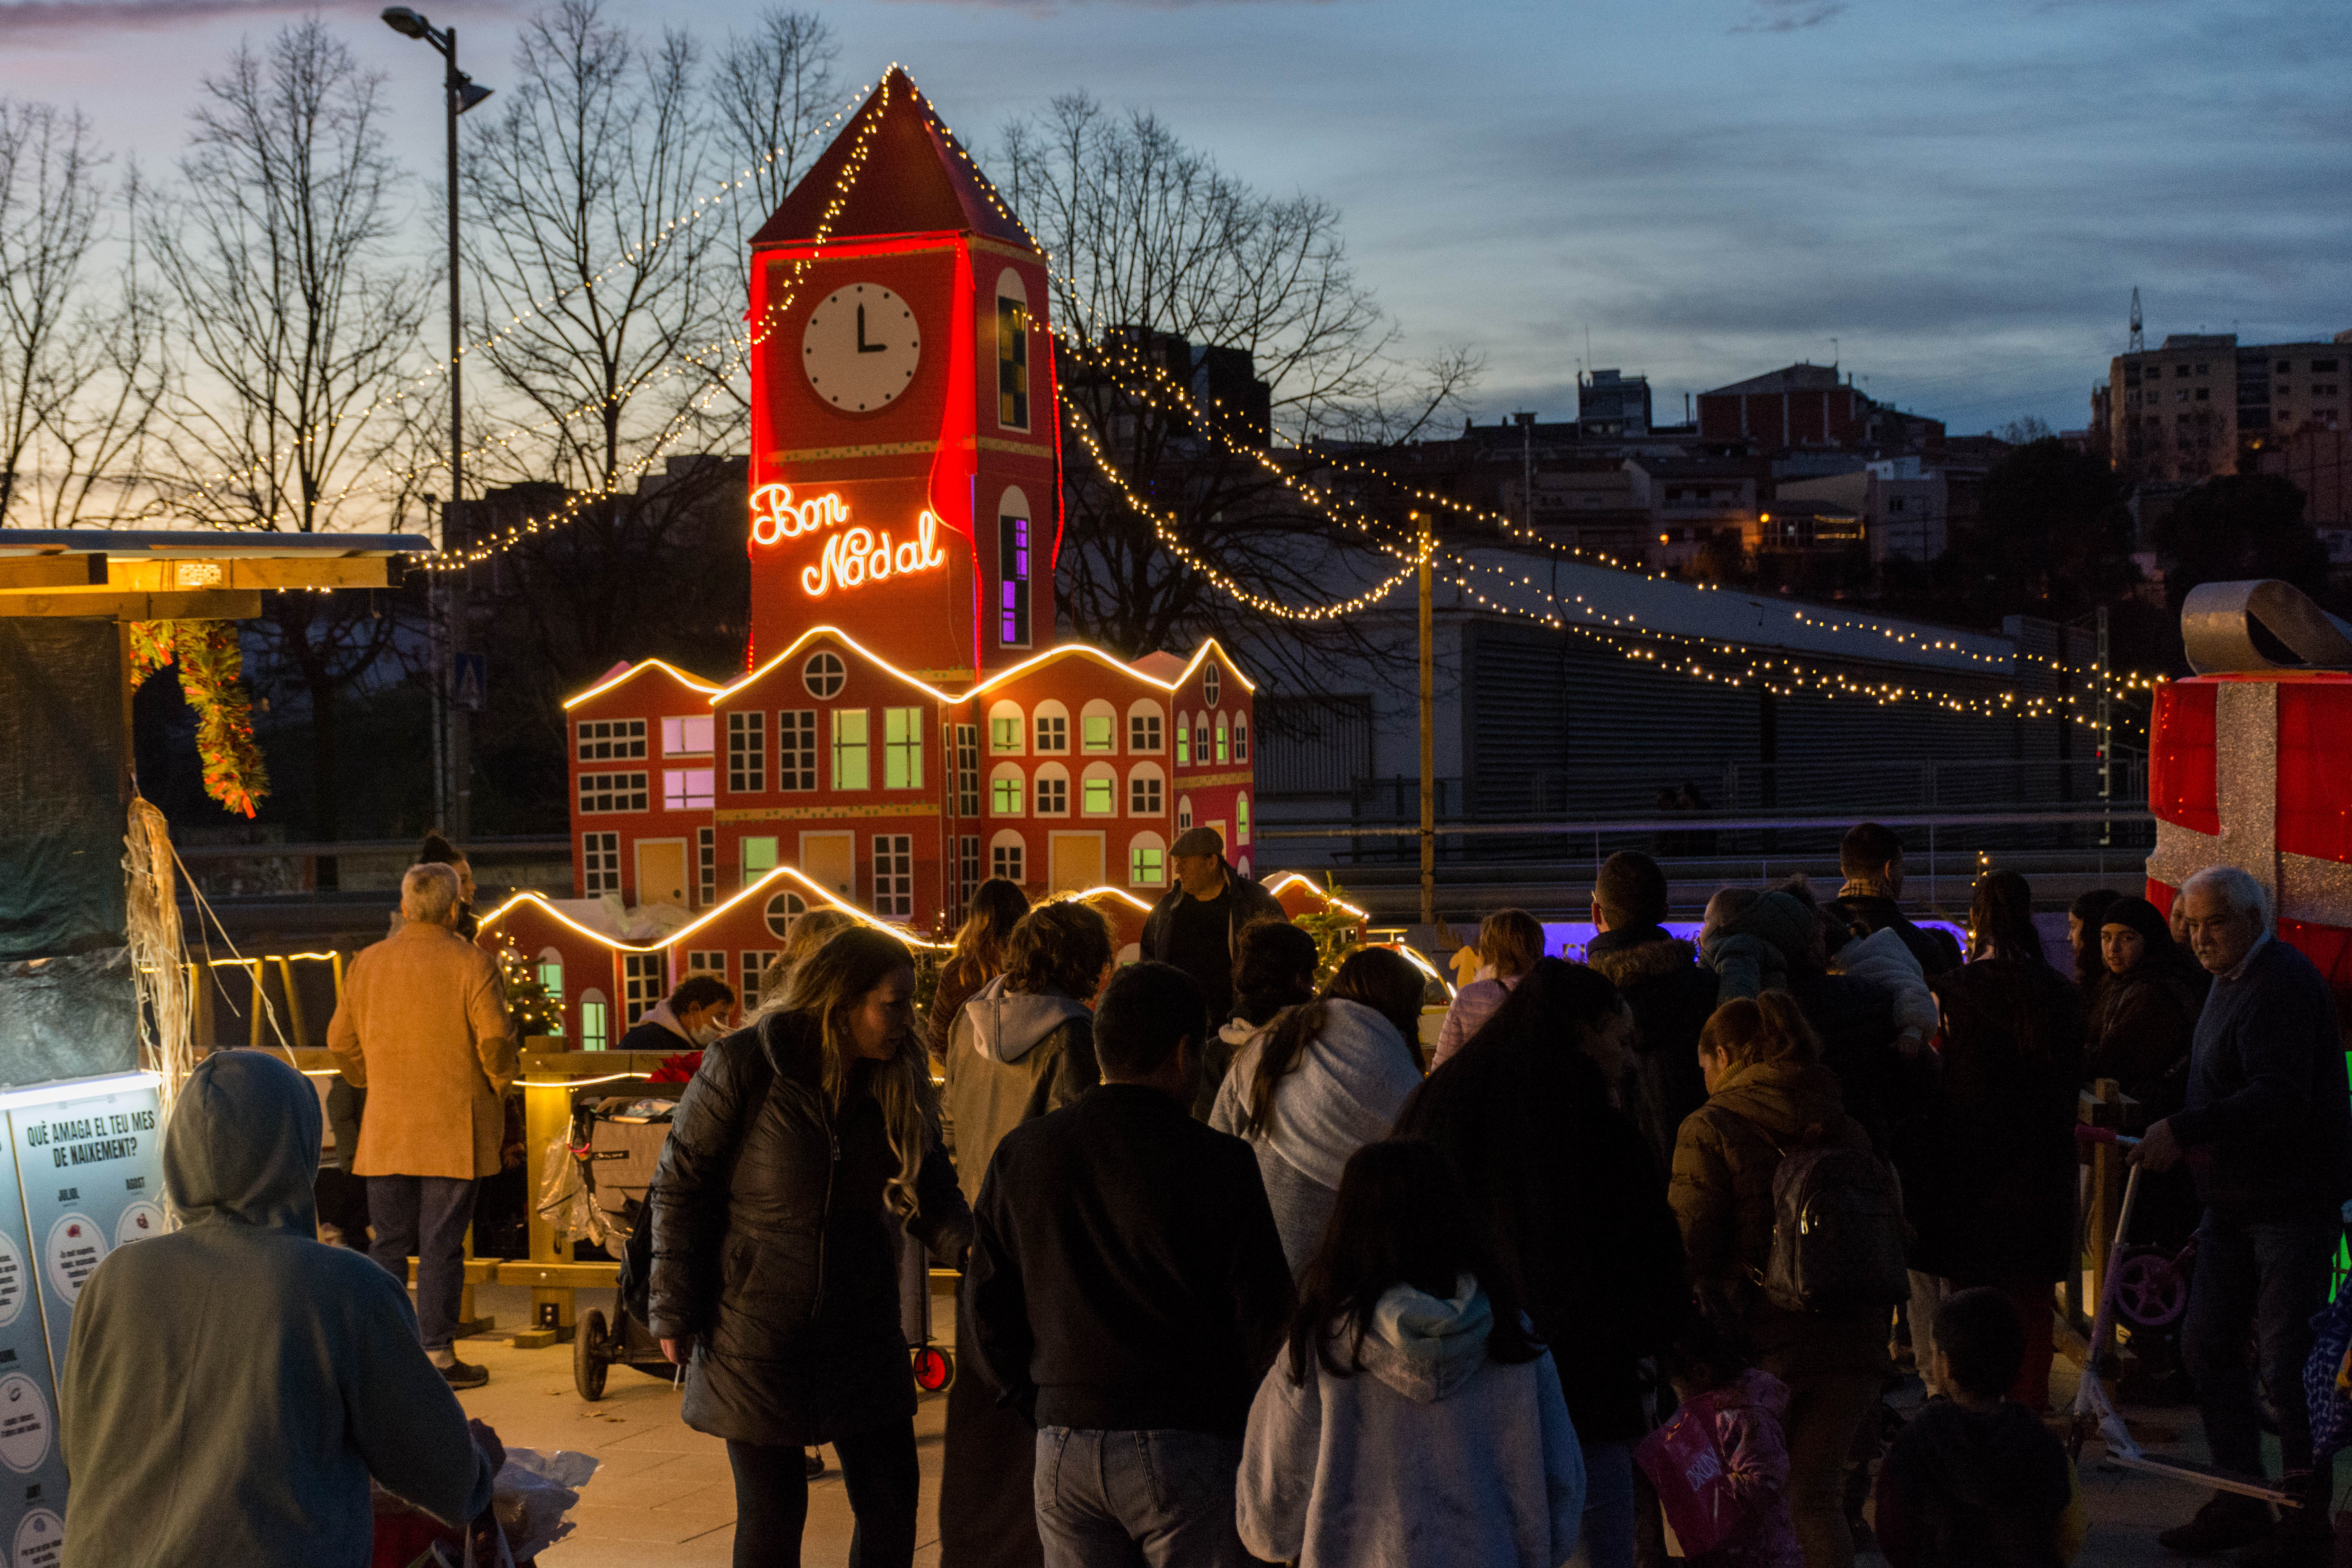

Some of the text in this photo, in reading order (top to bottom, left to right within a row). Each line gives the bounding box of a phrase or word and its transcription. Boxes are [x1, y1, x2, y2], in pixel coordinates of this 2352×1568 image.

[750, 483, 848, 545] Bon
[802, 510, 944, 596] Nadal
[27, 1120, 49, 1147] QUÈ
[52, 1119, 92, 1143] AMAGA
[94, 1117, 107, 1136] EL
[109, 1114, 128, 1134] TEU
[131, 1110, 154, 1132] MES
[53, 1137, 137, 1167] DE NAIXEMENT?
